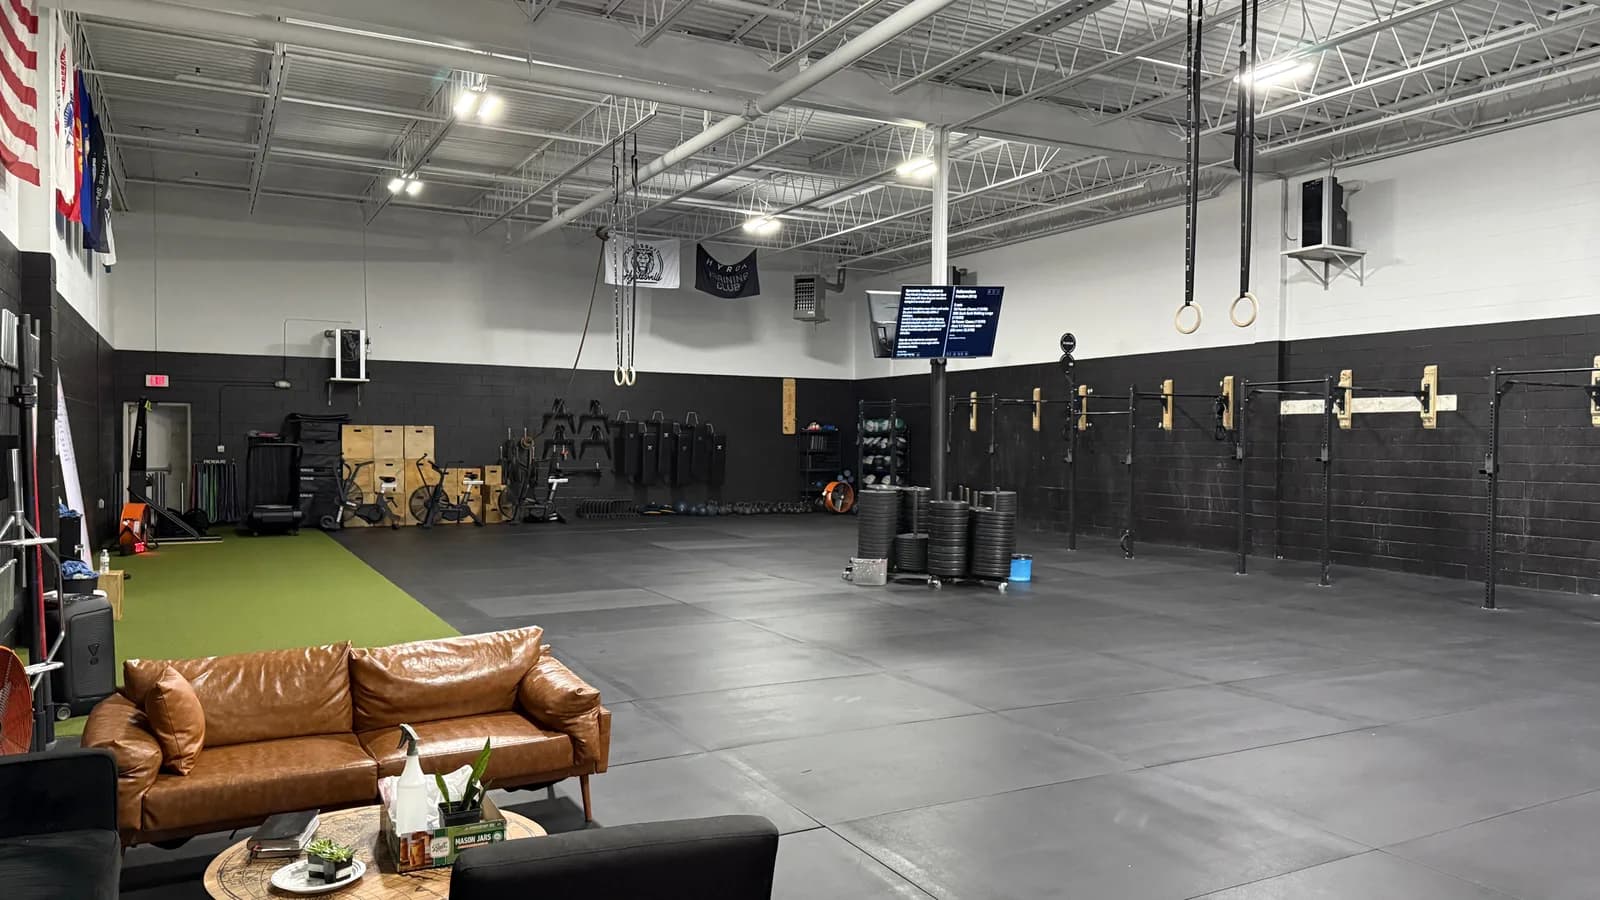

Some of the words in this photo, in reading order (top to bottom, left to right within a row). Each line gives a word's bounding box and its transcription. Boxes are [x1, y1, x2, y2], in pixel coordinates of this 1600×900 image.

[716, 281, 741, 292] CLUB
[455, 836, 476, 845] MASON
[477, 833, 492, 842] JARS
